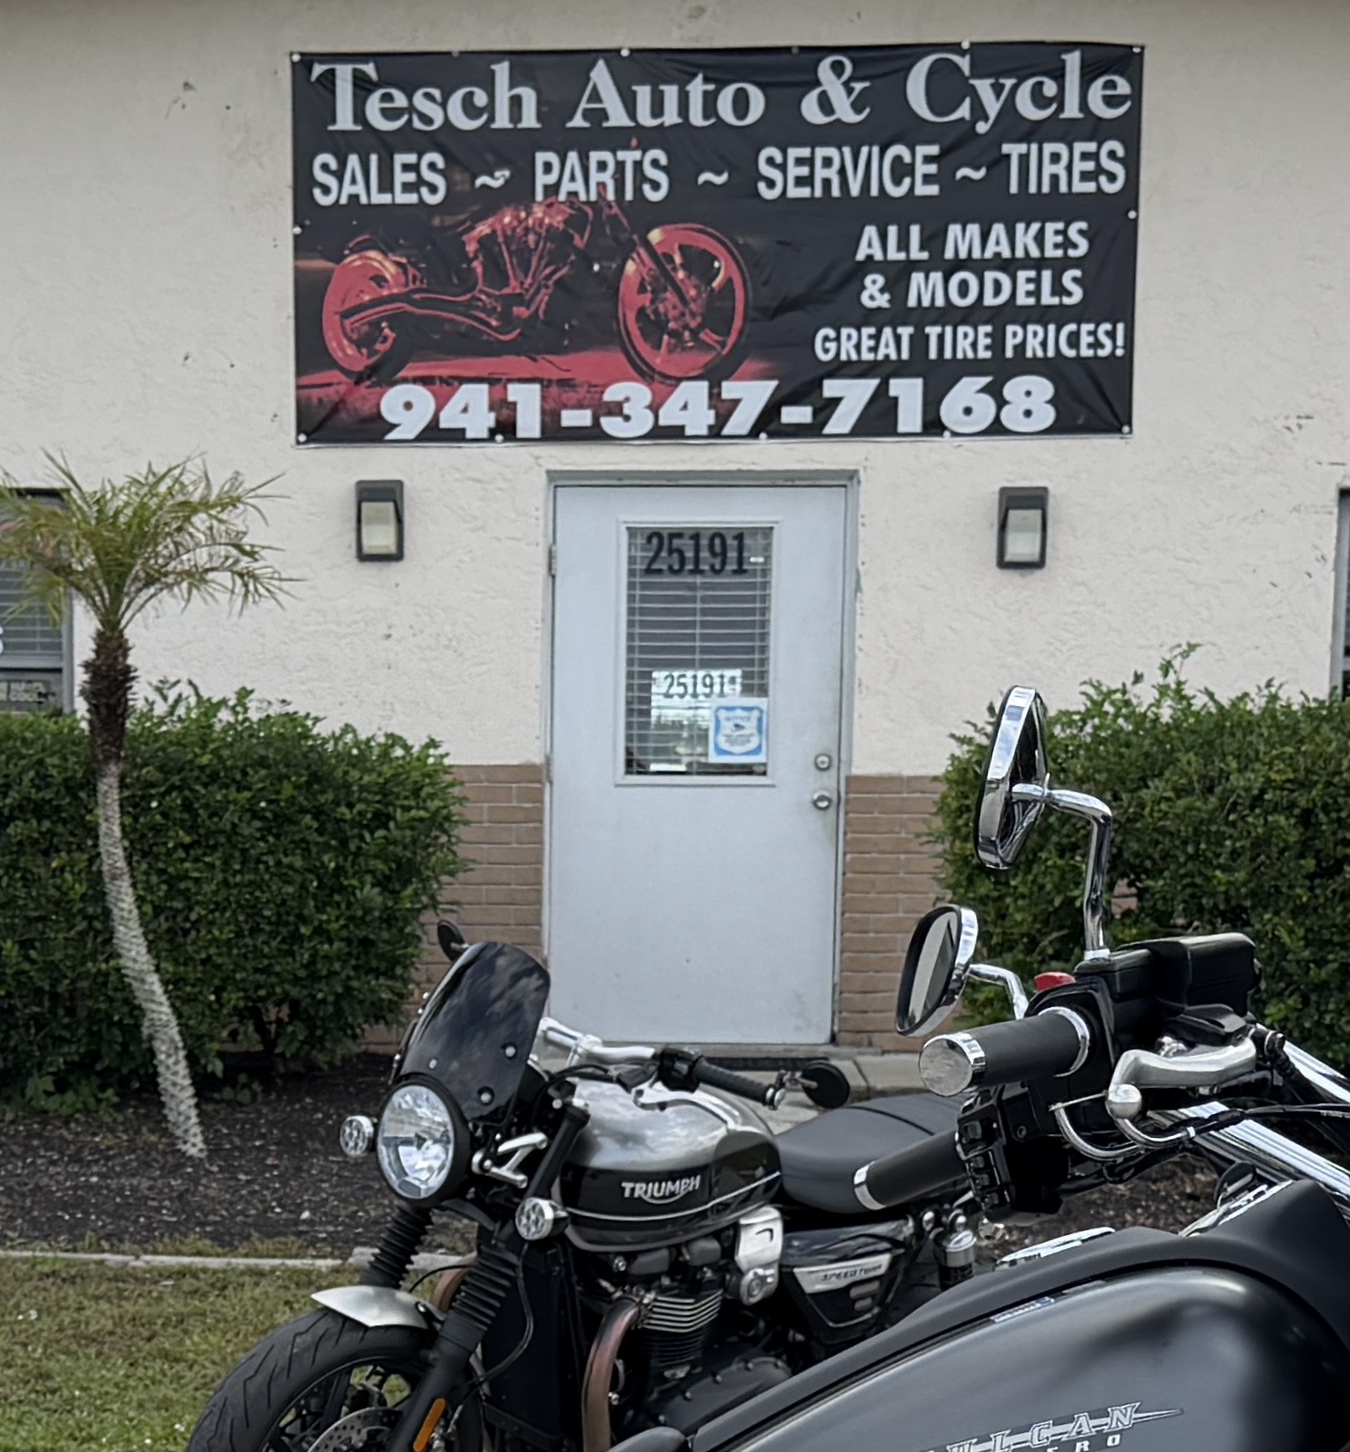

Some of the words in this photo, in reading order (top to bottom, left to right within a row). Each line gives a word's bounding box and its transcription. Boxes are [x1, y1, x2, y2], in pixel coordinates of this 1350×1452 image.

[311, 59, 541, 132] Tesch
[566, 63, 766, 129] Auto
[802, 56, 872, 127] &
[905, 52, 1133, 134] Cycle
[312, 151, 446, 207] SALES
[534, 148, 671, 204] PARTS
[757, 145, 941, 201] SERVICE
[1001, 140, 1127, 196] TIRES
[855, 224, 930, 263] ALL
[943, 219, 1091, 261] MAKES
[859, 273, 892, 310] &
[906, 269, 1086, 309] MODELS
[814, 326, 917, 364] GREAT
[924, 325, 993, 361] TIRE
[1003, 321, 1126, 361] PRICES!
[378, 375, 1057, 442] 941-347-7168
[644, 531, 749, 576] 25191
[663, 673, 728, 699] 25191
[621, 1174, 701, 1204] TRIUMPH
